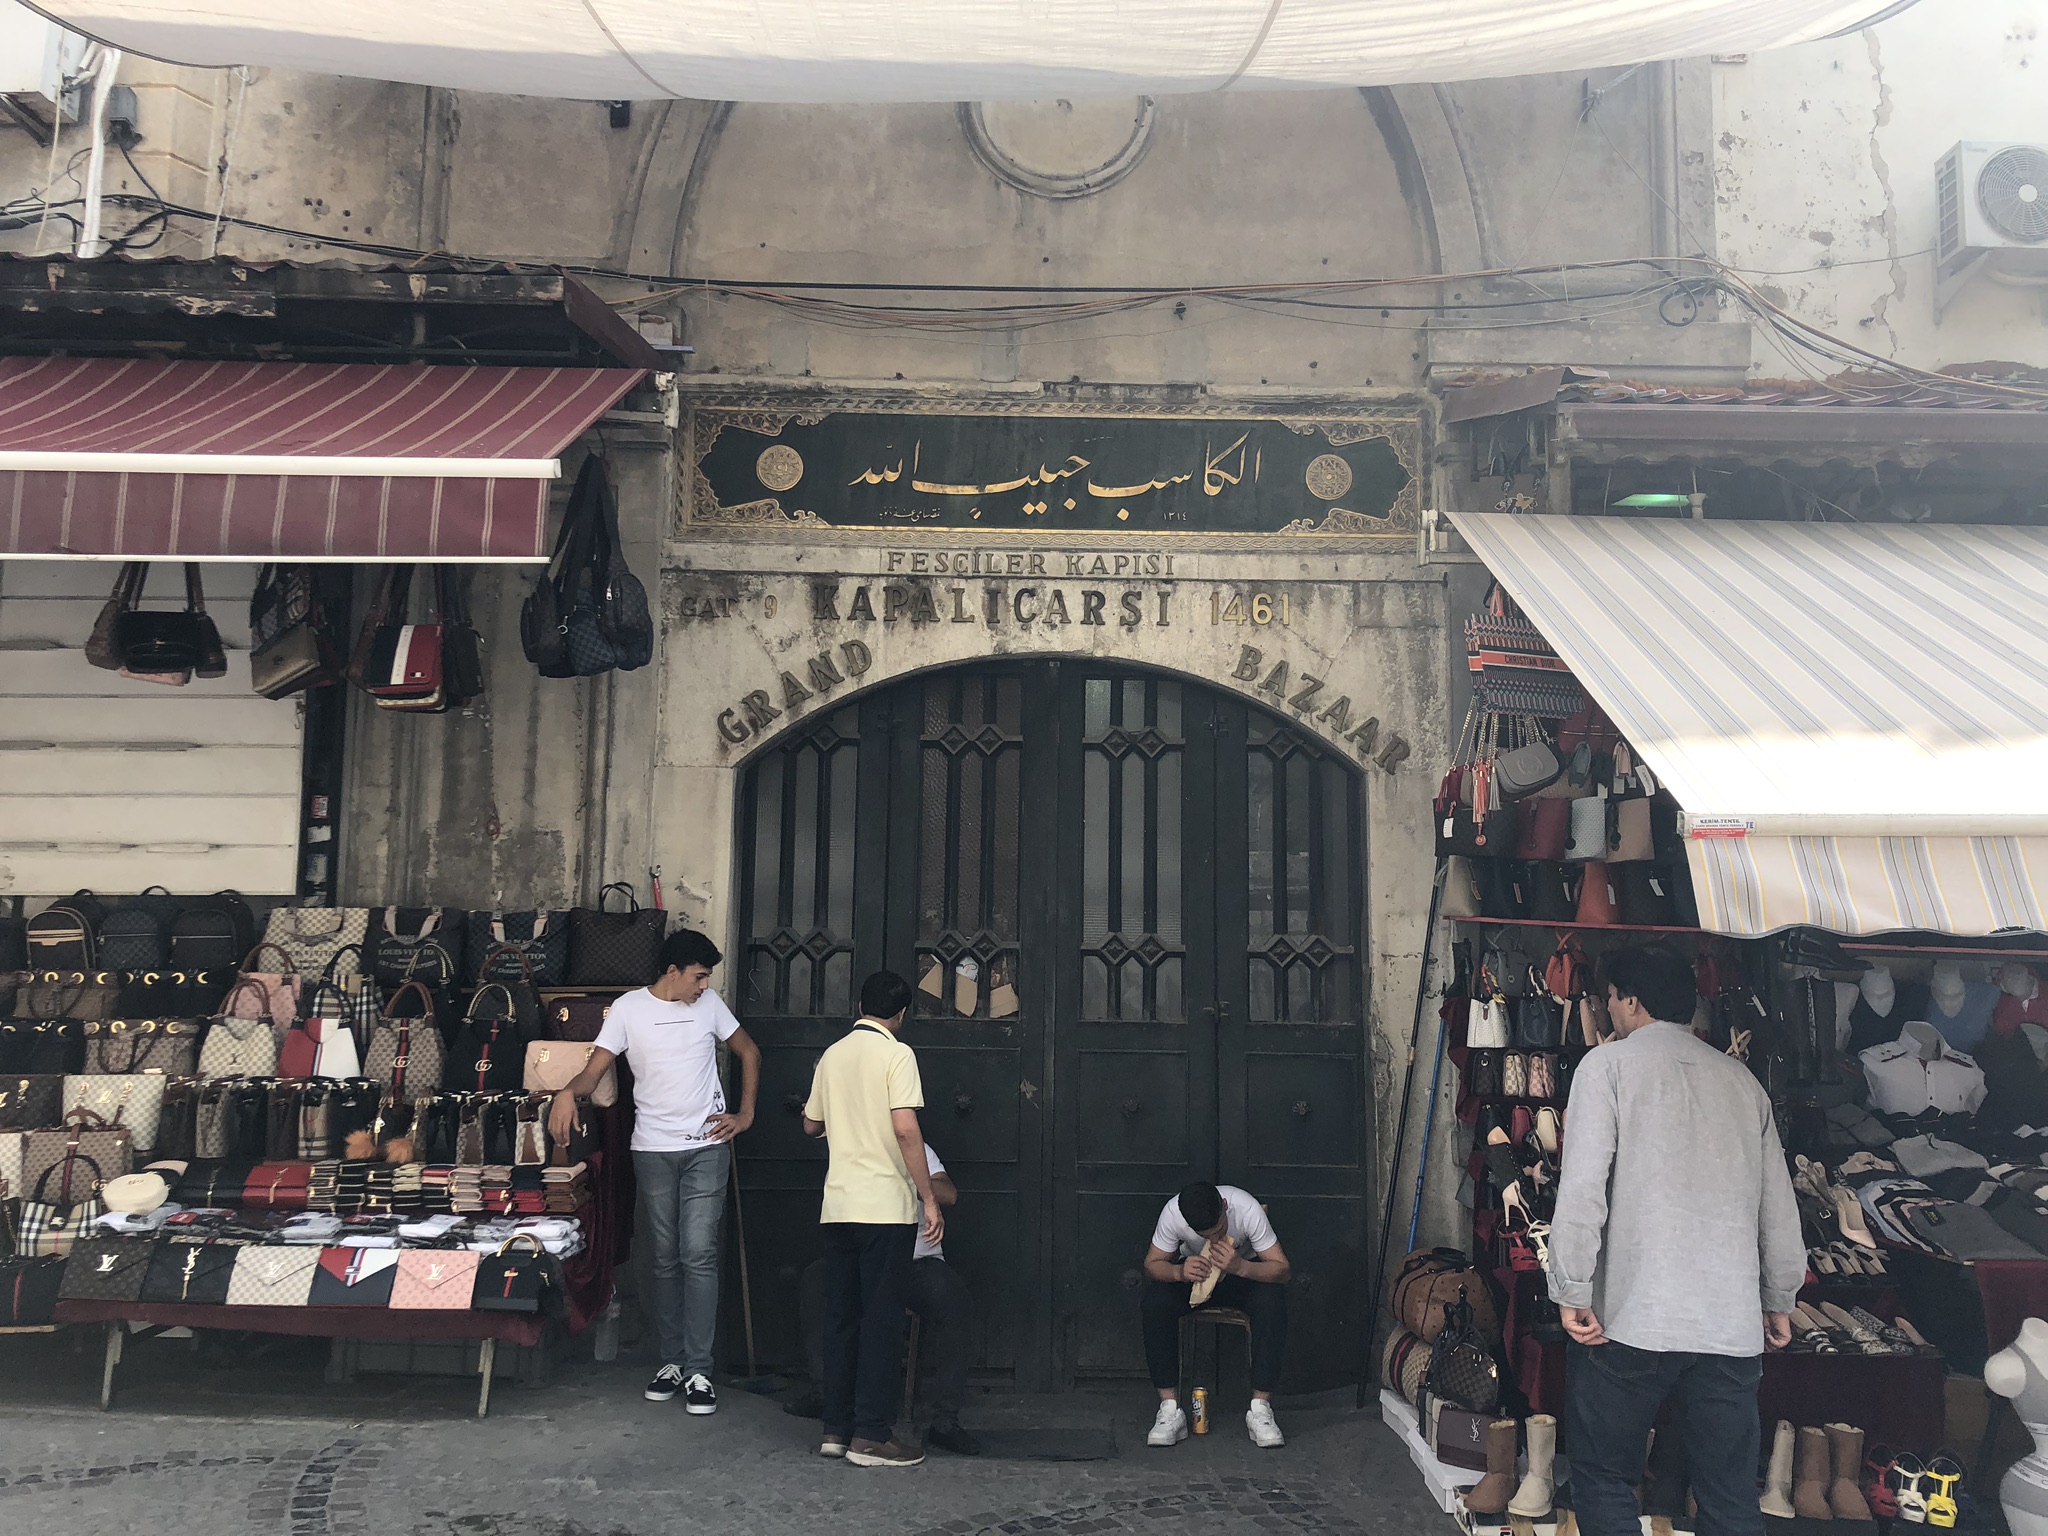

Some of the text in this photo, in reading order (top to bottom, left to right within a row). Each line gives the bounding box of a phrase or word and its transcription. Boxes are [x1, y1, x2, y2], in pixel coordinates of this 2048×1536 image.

[1066, 554, 1174, 576] KAPISI
[764, 595, 778, 619] 9
[1210, 592, 1290, 626] 1461
[1504, 654, 1557, 669] CHRISTIAN DIOR
[717, 639, 1411, 776] GRAND BAZAAR
